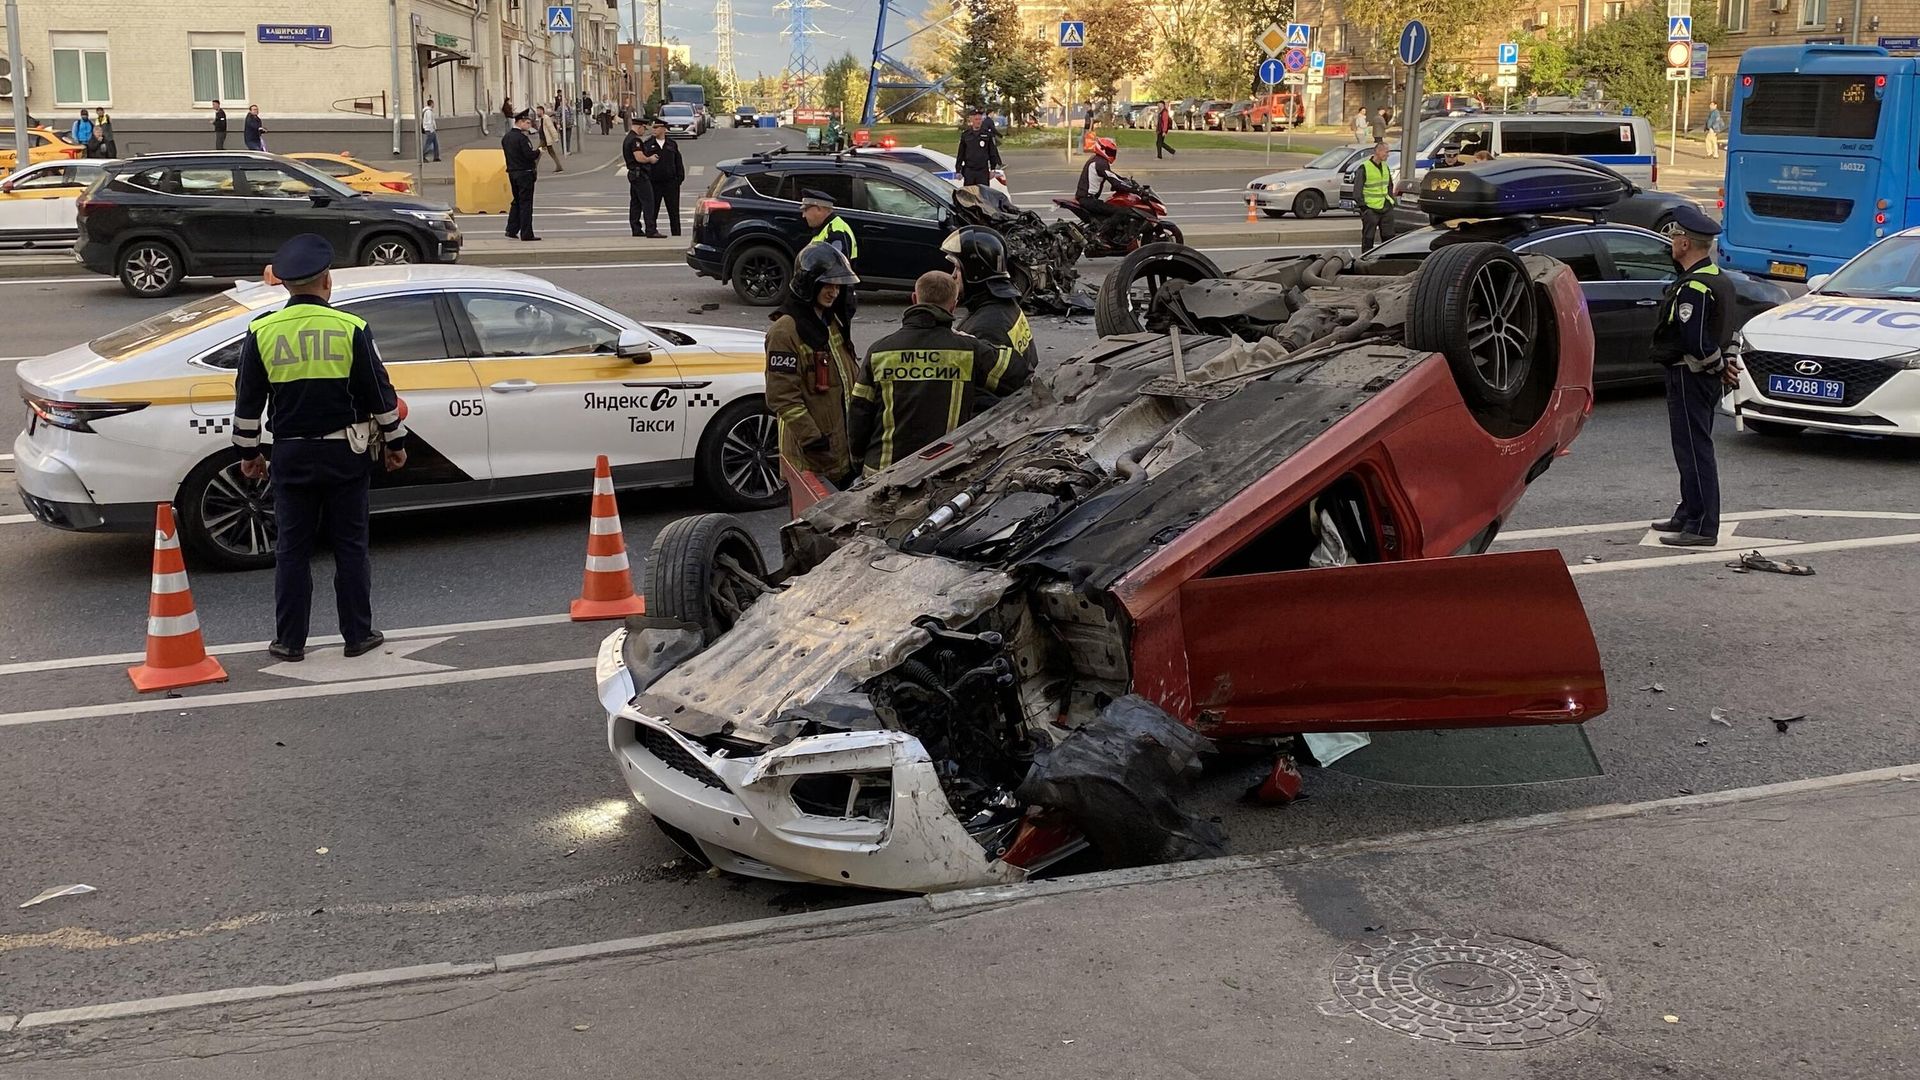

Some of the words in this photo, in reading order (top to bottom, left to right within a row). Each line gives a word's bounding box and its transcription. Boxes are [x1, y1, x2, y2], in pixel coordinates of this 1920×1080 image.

[318, 28, 325, 38] 7
[1504, 45, 1516, 62] P
[1778, 305, 1920, 329] ДПС
[271, 329, 347, 366] ДПС
[770, 355, 797, 368] 0242
[900, 351, 940, 364] МЧС
[883, 366, 961, 380] РОССИИ
[1787, 378, 1818, 395] 2988
[1825, 382, 1839, 393] 99
[449, 399, 484, 417] 055
[584, 391, 648, 412] Яндекс
[650, 388, 678, 412] Go
[627, 416, 675, 433] Такси
